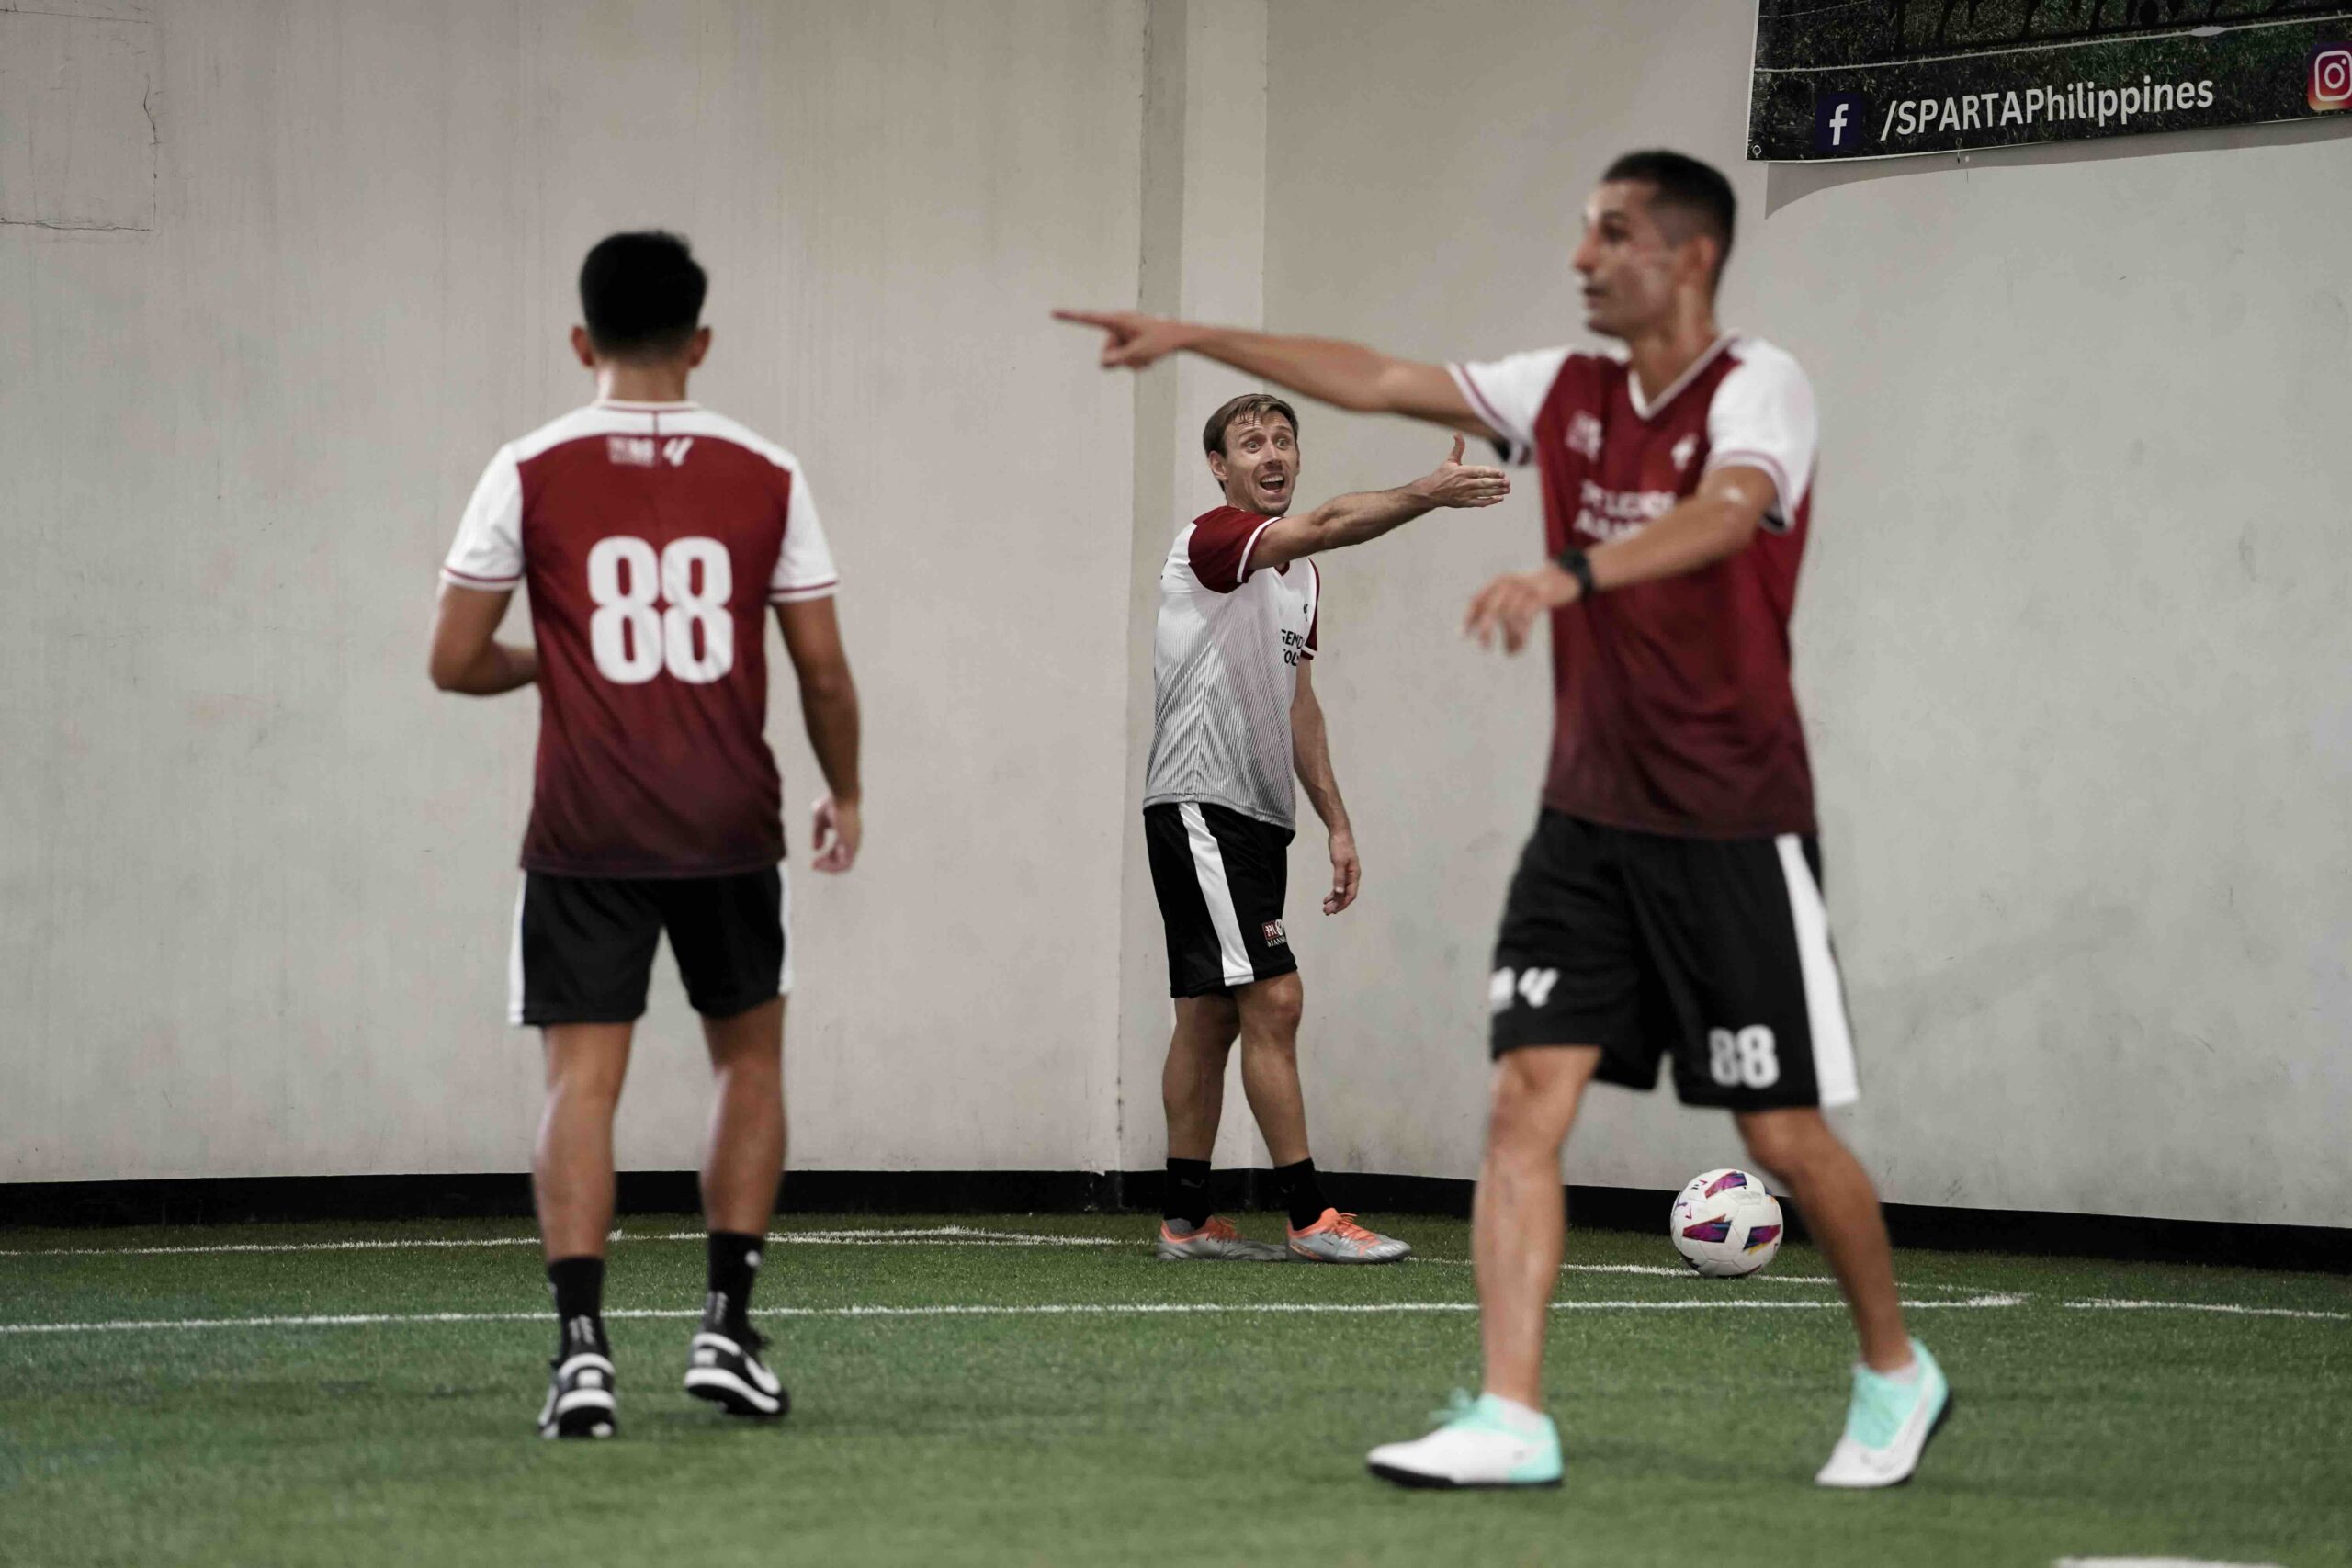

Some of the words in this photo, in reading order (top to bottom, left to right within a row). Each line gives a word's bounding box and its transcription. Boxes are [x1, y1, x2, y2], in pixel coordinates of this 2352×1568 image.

[1880, 75, 2214, 141] /SPARTAPhilippines
[586, 535, 734, 684] 88
[1708, 1024, 1780, 1089] 88
